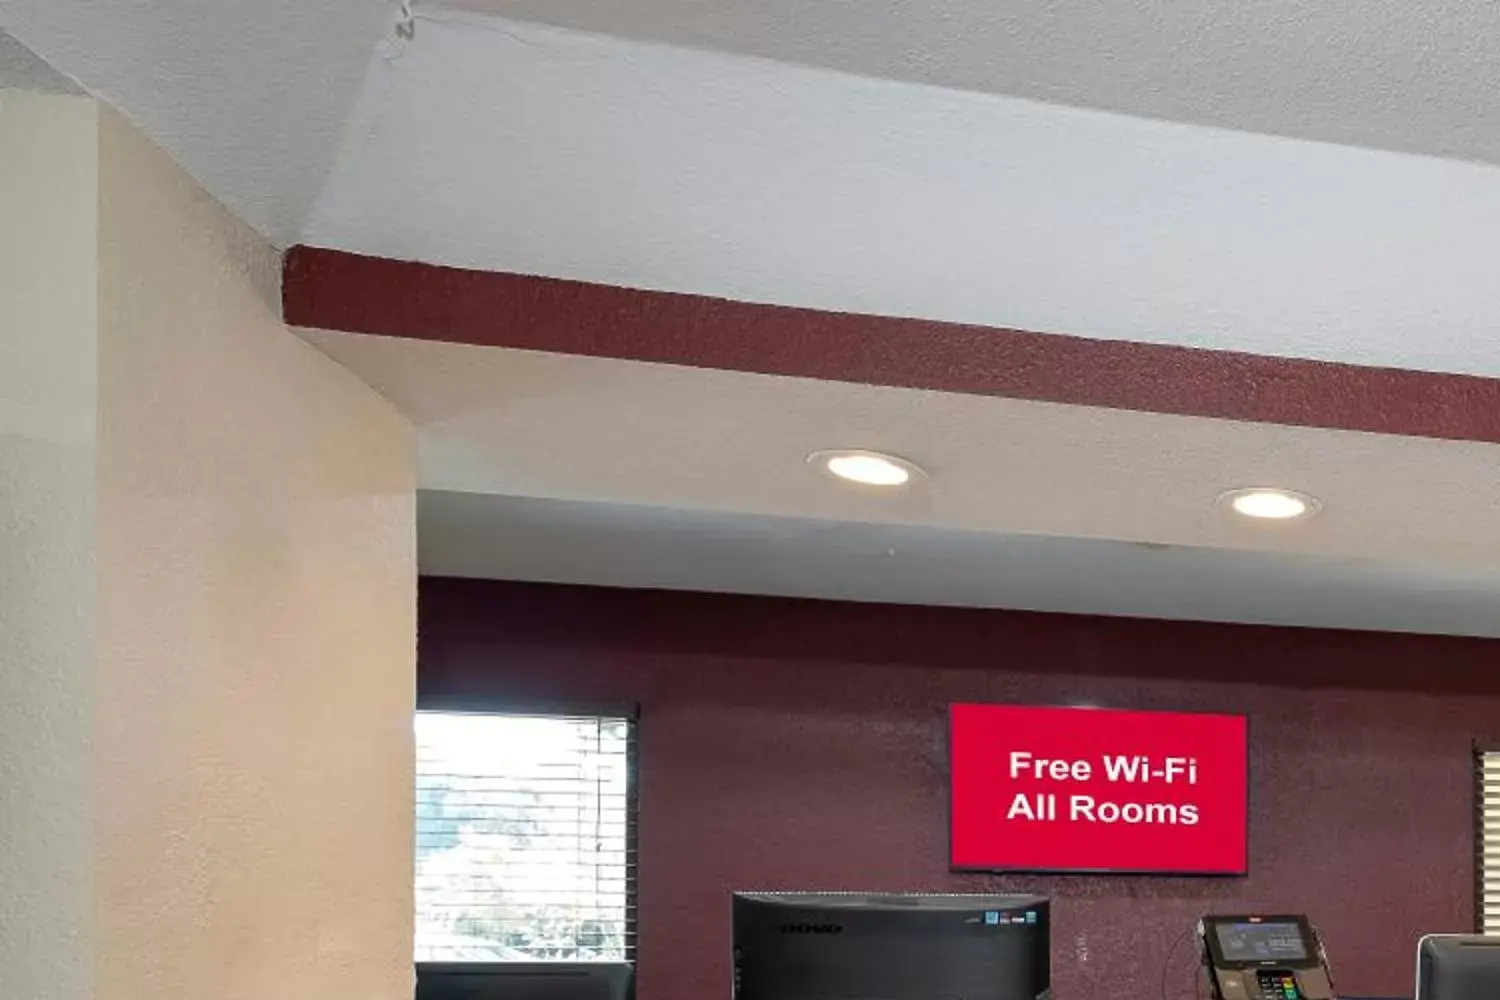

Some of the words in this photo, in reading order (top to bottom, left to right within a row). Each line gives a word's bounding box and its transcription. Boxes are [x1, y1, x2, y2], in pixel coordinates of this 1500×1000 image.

[1009, 752, 1092, 781] Free
[1103, 755, 1197, 784] Wi-Fi
[1007, 793, 1056, 821] All
[1070, 795, 1199, 825] Rooms
